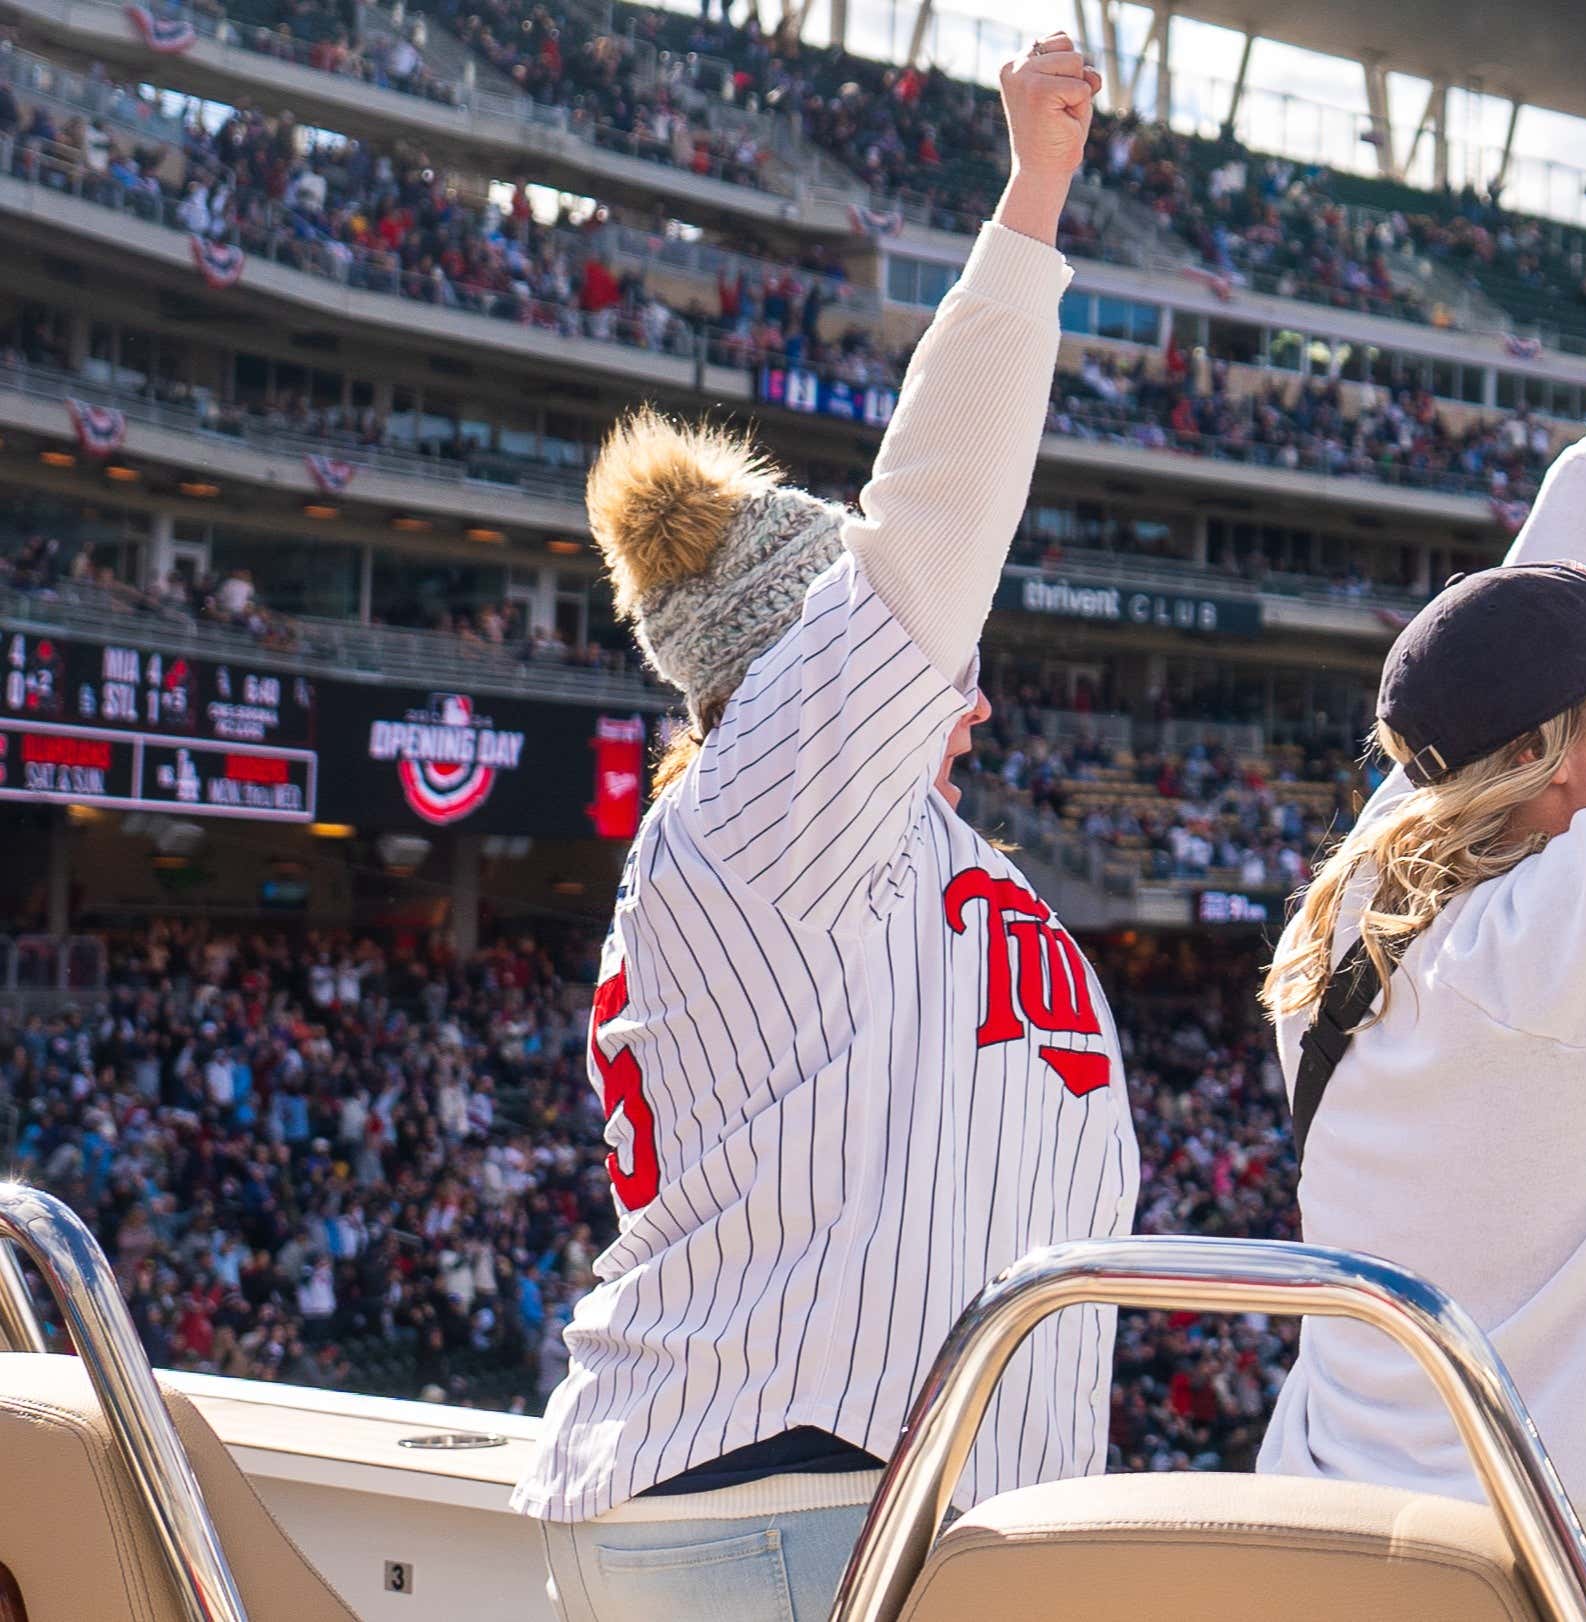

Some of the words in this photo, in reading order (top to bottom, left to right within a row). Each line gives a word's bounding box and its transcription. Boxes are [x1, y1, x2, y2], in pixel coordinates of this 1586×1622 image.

[1129, 594, 1218, 631] CLUB
[369, 720, 476, 762] OPENING
[476, 729, 525, 769] DAY
[390, 1564, 405, 1591] 3
